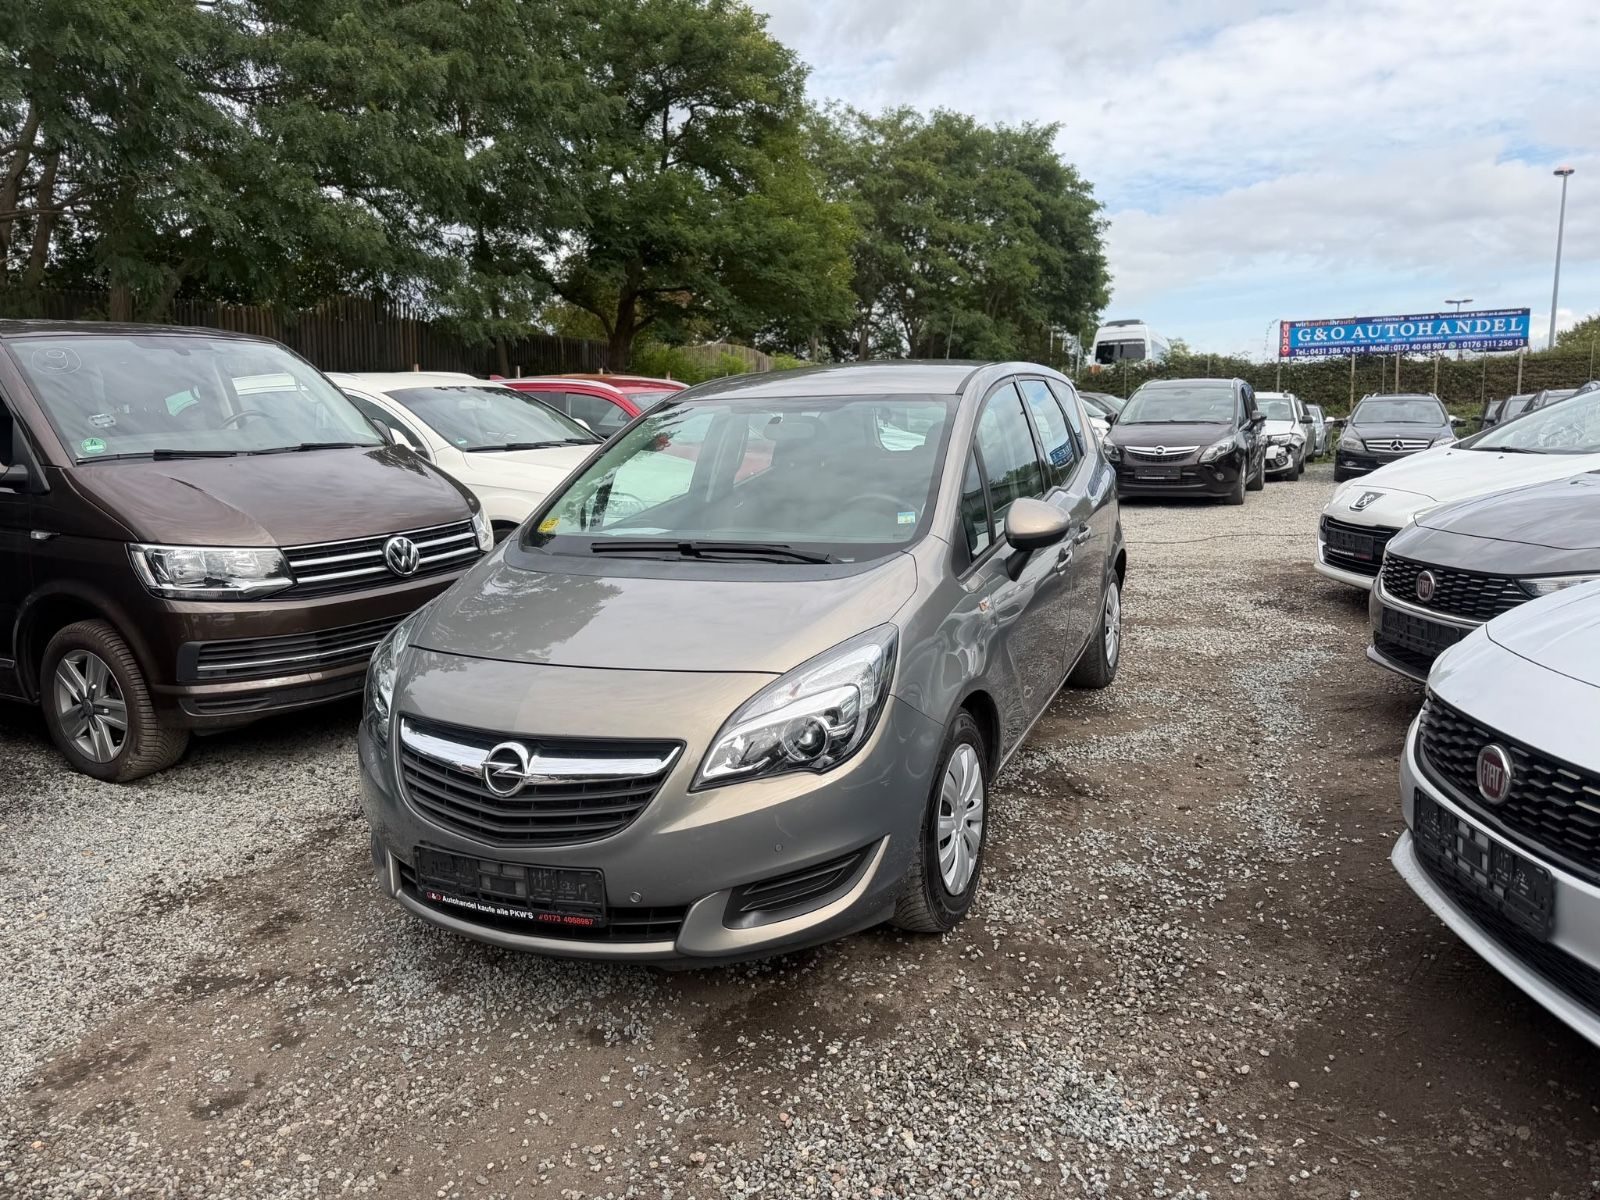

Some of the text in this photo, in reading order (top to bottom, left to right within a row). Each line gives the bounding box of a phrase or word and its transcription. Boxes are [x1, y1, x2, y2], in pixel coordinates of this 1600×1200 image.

[1297, 318, 1523, 342] G&O AUTOHANDEL
[1432, 342, 1446, 350] 987
[1483, 340, 1496, 348] 311
[1498, 339, 1513, 347] 256
[1482, 759, 1502, 791] FIAT
[442, 895, 476, 909] Autohandel
[477, 903, 495, 913] kaufe
[496, 908, 509, 916] alle
